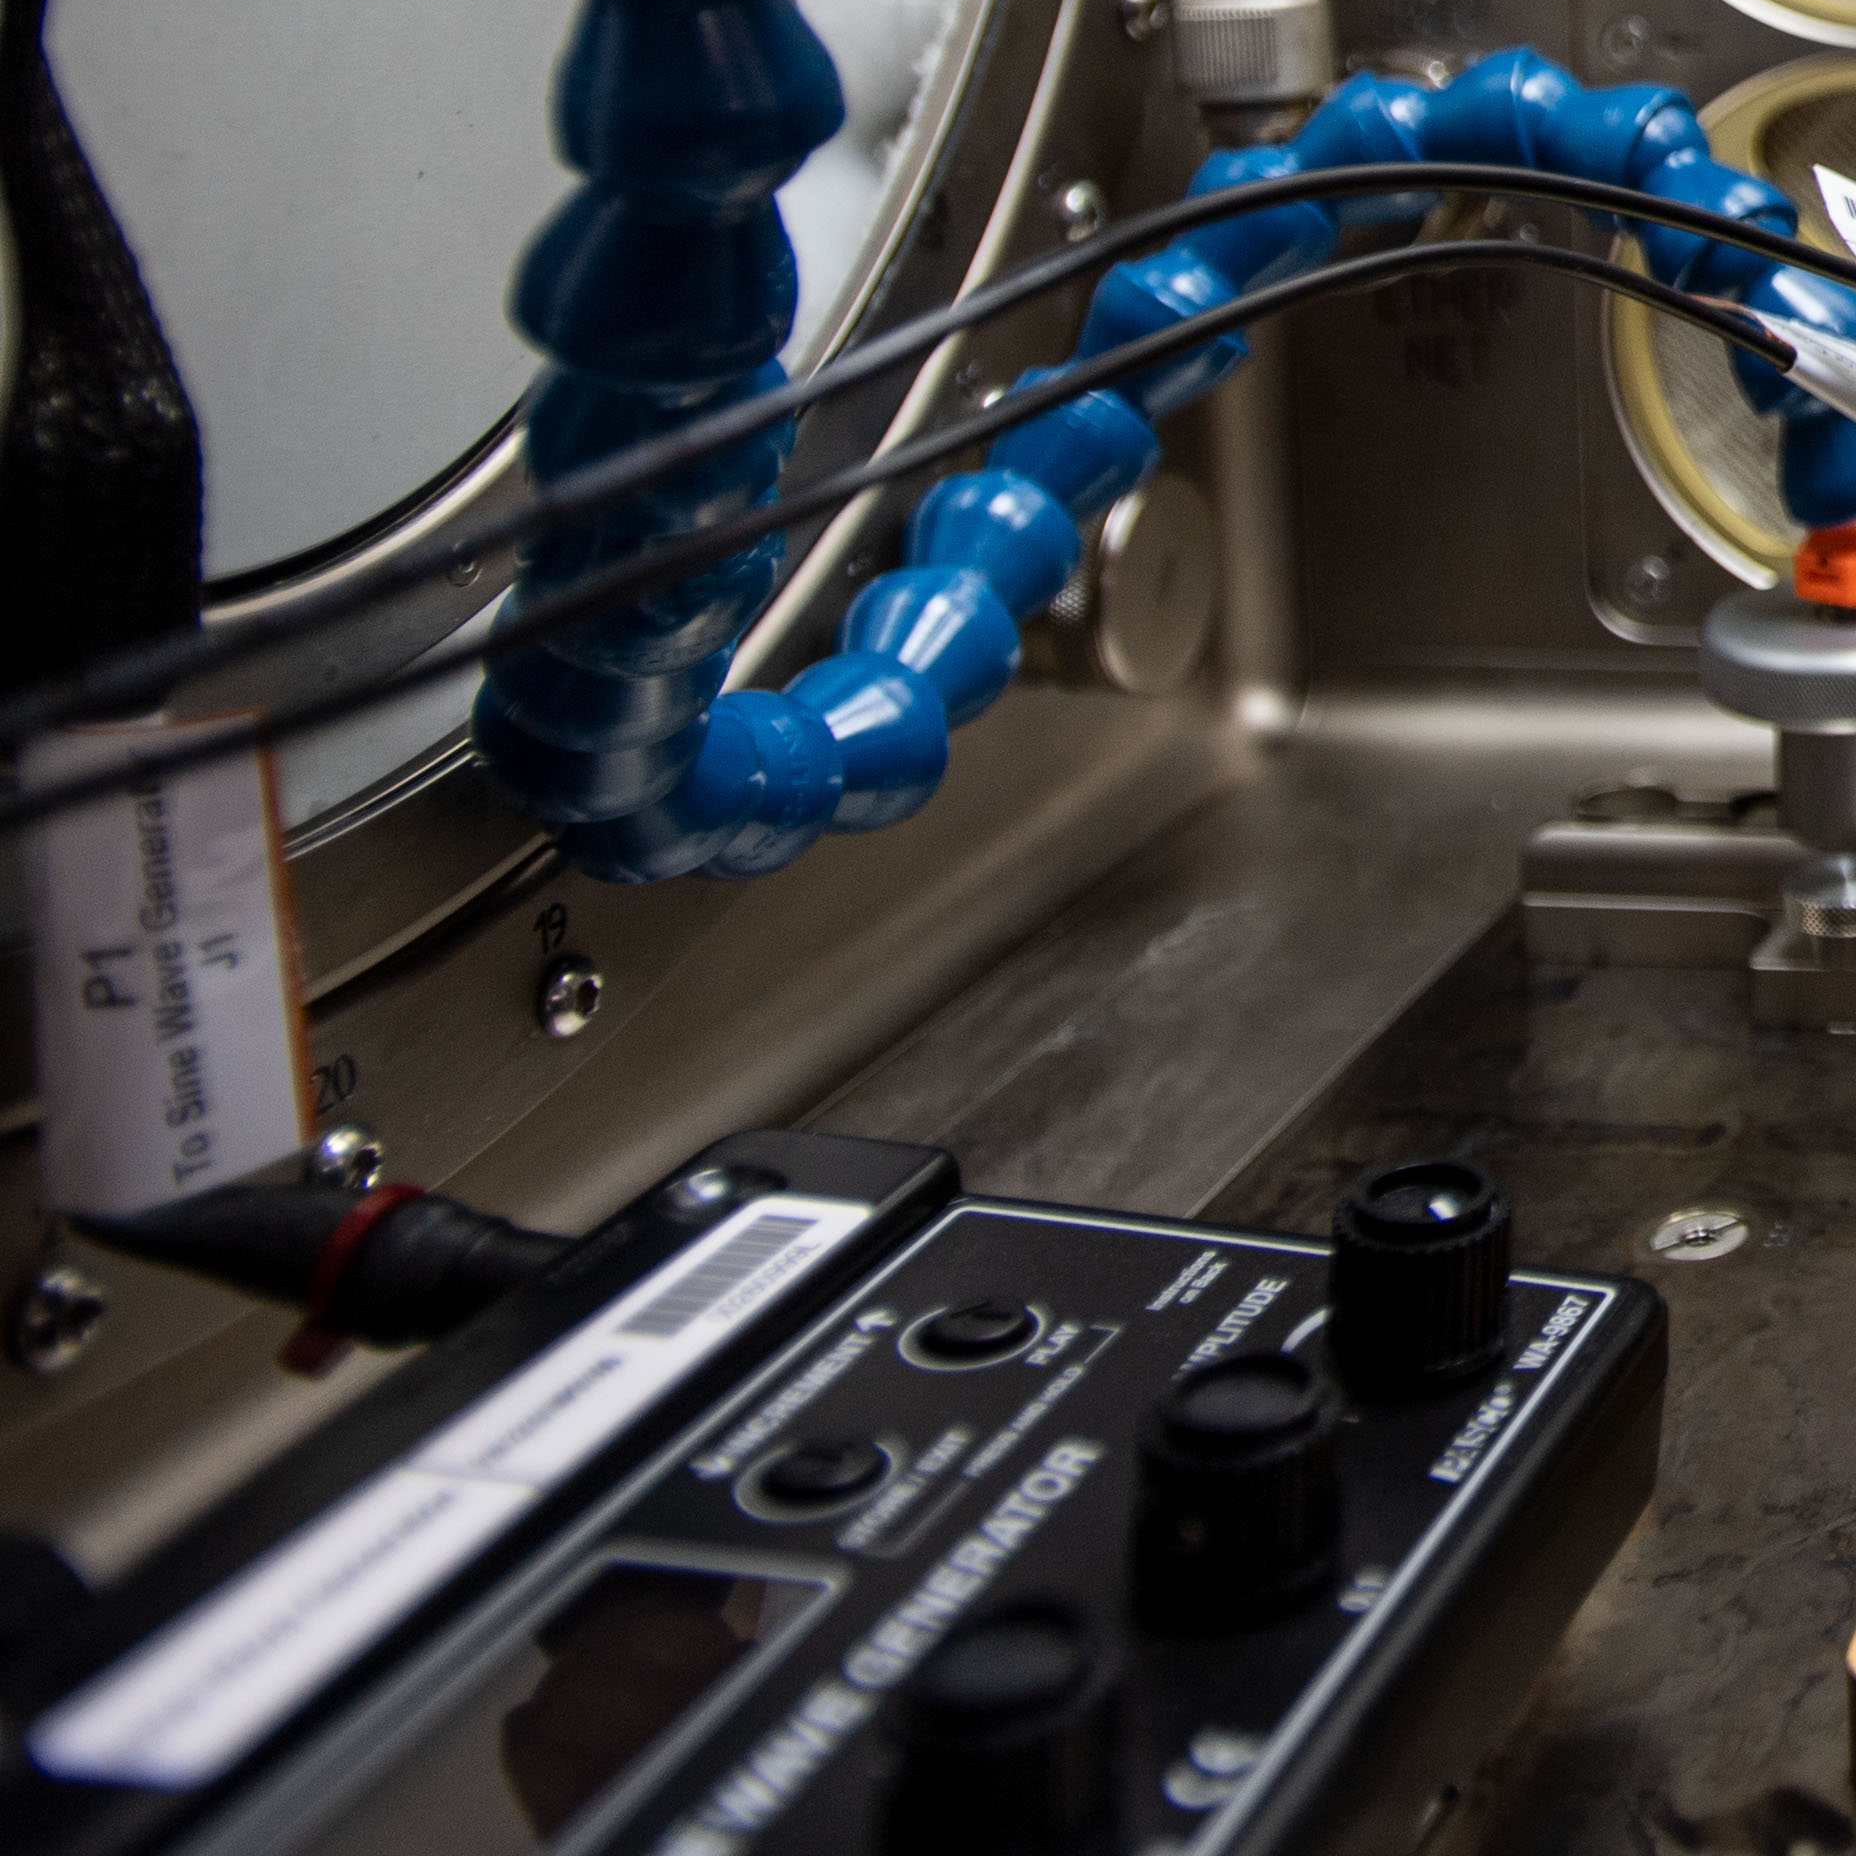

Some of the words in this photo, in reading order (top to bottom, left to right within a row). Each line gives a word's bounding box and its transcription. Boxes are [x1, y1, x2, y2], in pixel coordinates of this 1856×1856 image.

[200, 931, 241, 972] J1
[532, 901, 568, 956] 19
[81, 940, 140, 1014] P1
[150, 937, 196, 1044] Wave
[164, 1042, 208, 1129] Sine
[171, 1130, 216, 1186] To
[1145, 1250, 1215, 1313] Instructions
[1024, 1320, 1080, 1368] PLAY
[1170, 1276, 1290, 1382] PLITUDE
[1512, 1294, 1590, 1372] WA-9867
[728, 1331, 876, 1462] INCREMENT
[713, 1679, 877, 1834] WAVE
[841, 1440, 1103, 1693] GENERATOR
